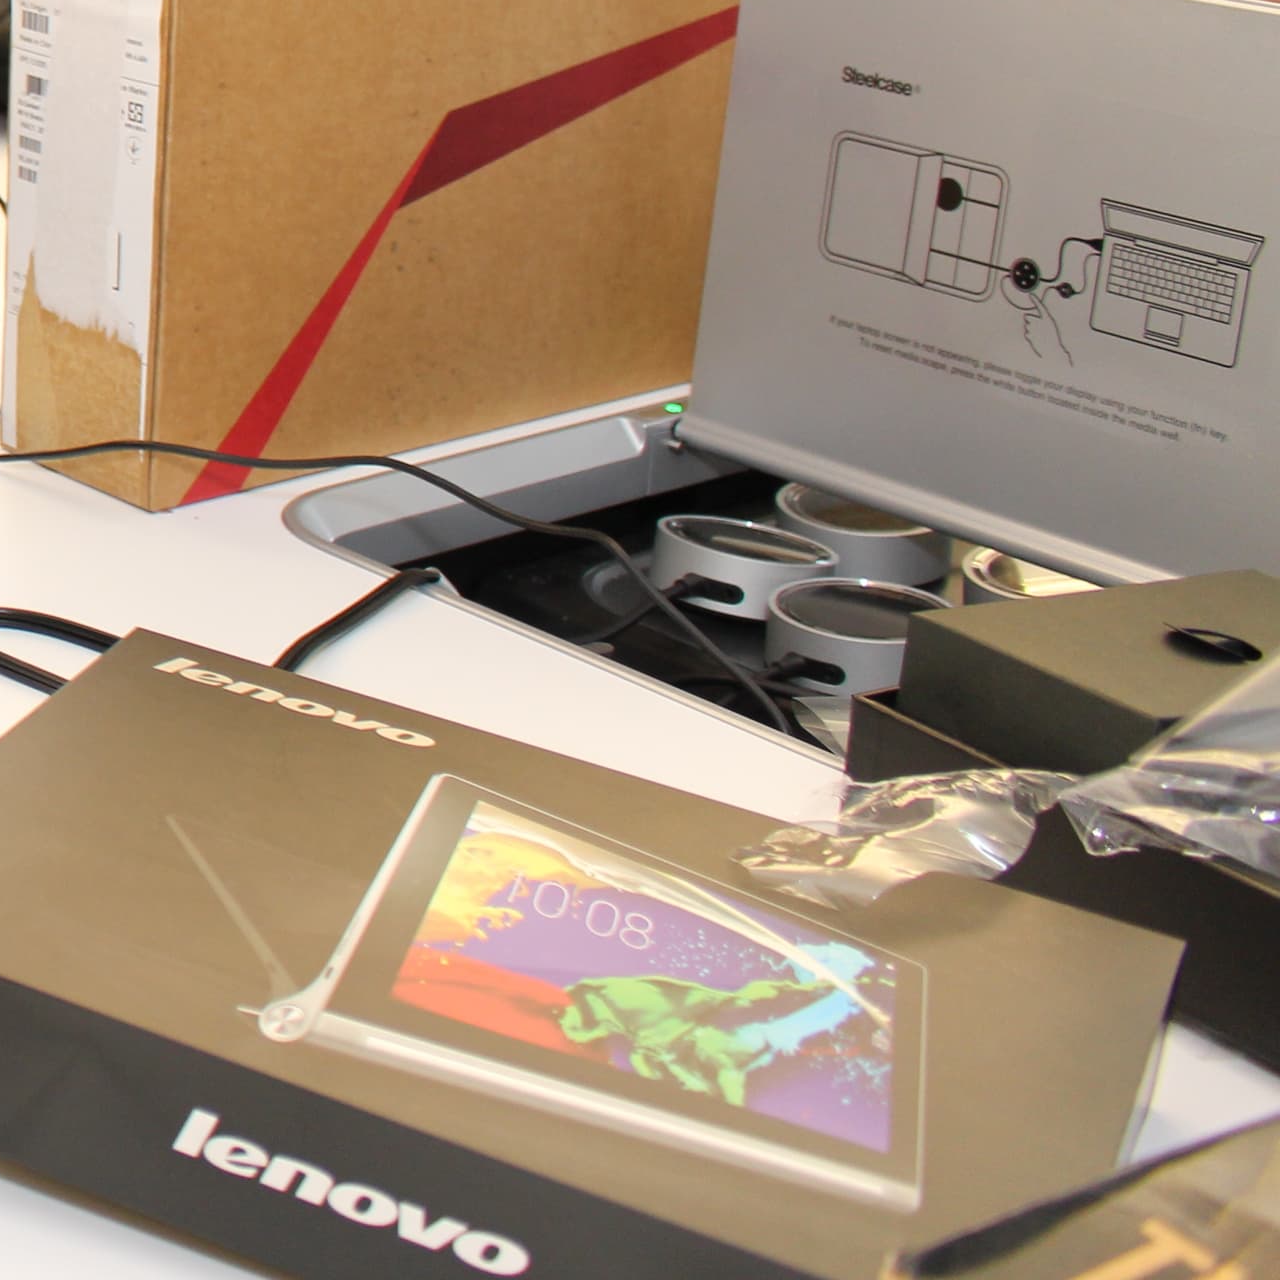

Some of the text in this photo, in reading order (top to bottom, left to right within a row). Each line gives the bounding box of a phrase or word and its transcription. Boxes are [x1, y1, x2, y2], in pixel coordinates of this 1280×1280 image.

[842, 66, 912, 96] Steelcase
[152, 657, 437, 747] lenovo
[507, 873, 653, 950] 10:08
[172, 1108, 531, 1276] lenovo
